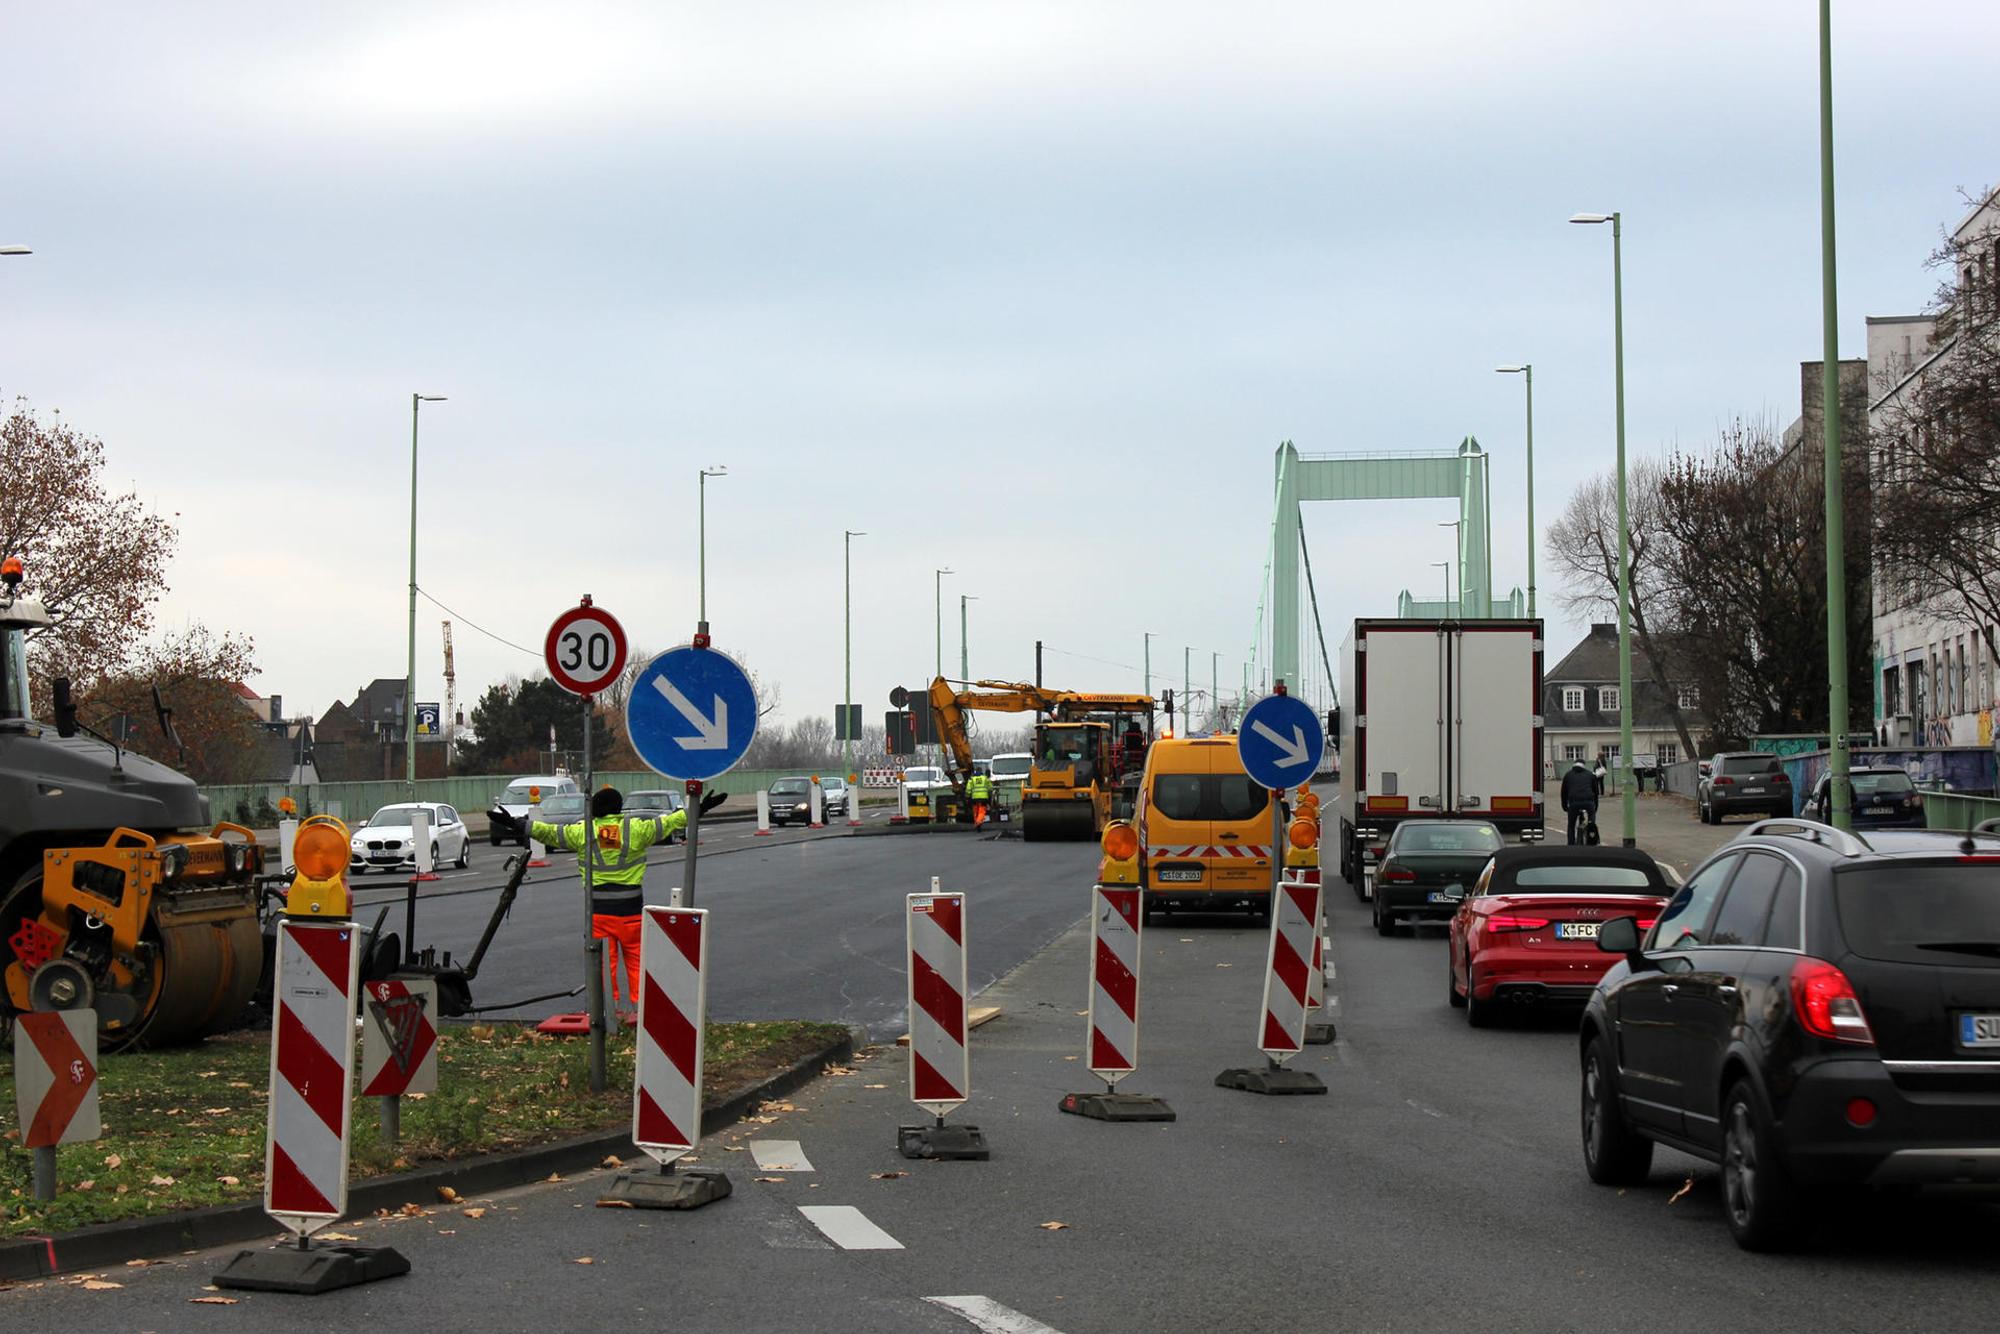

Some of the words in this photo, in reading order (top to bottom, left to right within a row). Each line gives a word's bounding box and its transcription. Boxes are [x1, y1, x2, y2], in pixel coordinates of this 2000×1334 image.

[561, 632, 609, 671] 30
[1562, 925, 1571, 936] K
[1577, 925, 1593, 936] FC
[1976, 1019, 2000, 1039] SU
